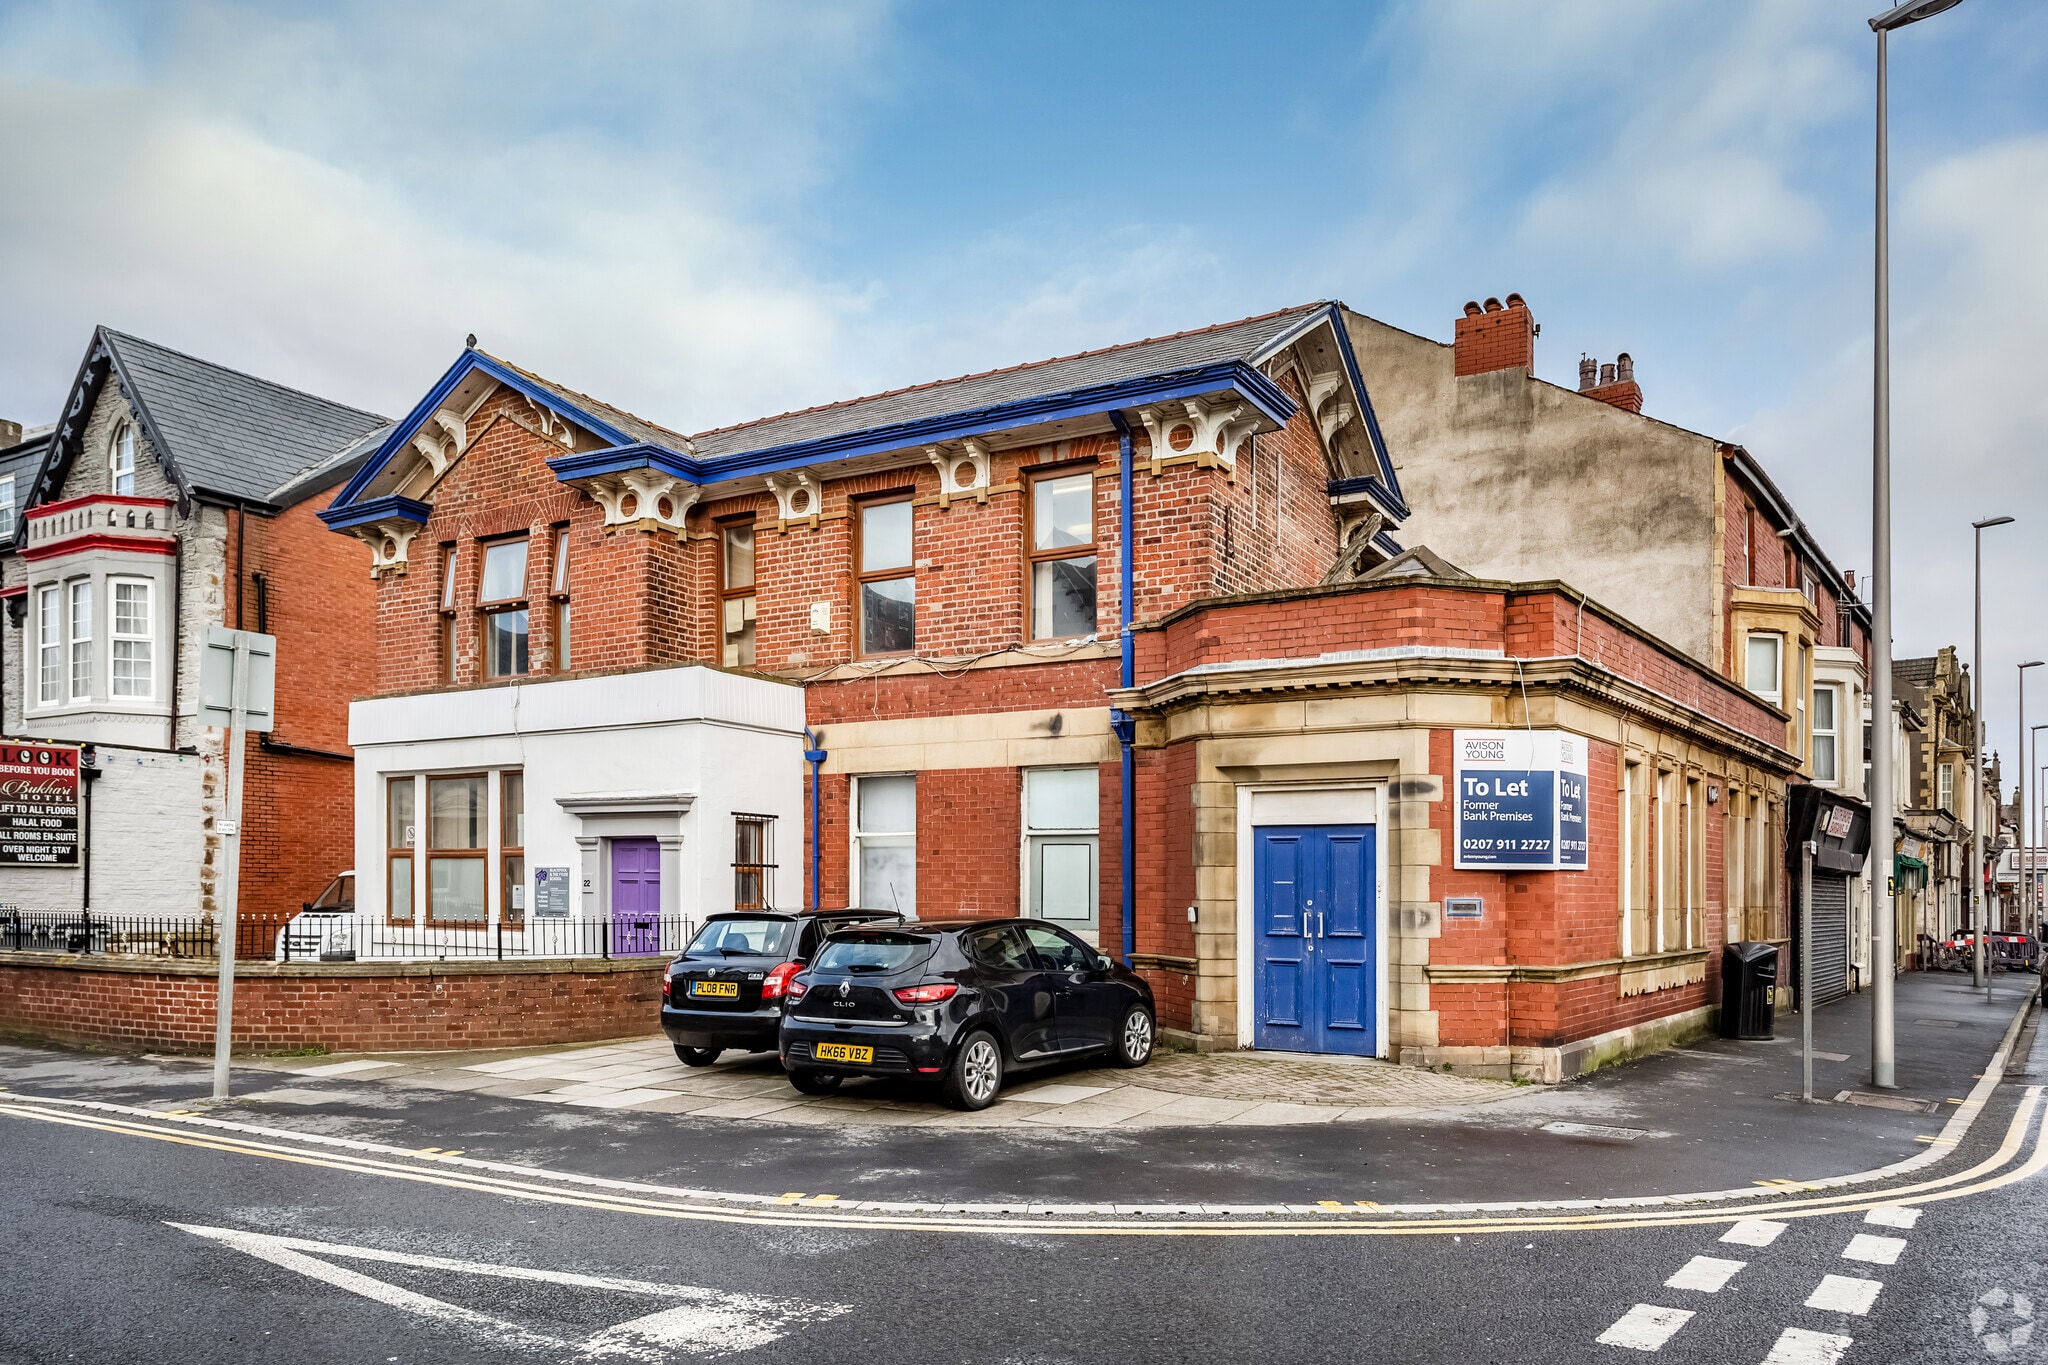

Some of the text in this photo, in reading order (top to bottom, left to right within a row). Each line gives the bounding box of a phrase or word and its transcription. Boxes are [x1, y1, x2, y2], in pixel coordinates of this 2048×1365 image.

[1465, 741, 1504, 750] AVISON
[2, 748, 72, 766] LOOK
[1465, 750, 1504, 759] YOUNG
[0, 764, 75, 777] BEFORE YOU BOOK
[0, 778, 72, 797] Bukhari
[1463, 778, 1528, 796] To Let
[1560, 779, 1581, 799] To Let
[20, 794, 73, 802] HOTEL
[16, 804, 27, 813] TO
[29, 805, 44, 814] ALL
[46, 806, 77, 815] FLOORS
[1463, 800, 1499, 810] Former
[1463, 811, 1533, 821] Bank Premises
[12, 817, 62, 827] HALAL FOOD
[13, 831, 41, 840] ROOMS
[43, 832, 77, 841] EN-SUITE
[2, 845, 71, 854] OVER NIGHT STAY
[1463, 839, 1550, 850] 0207 911 2727
[17, 854, 58, 862] WELCOME
[583, 879, 591, 887] 22
[696, 983, 736, 995] PL08 FNR
[820, 1045, 868, 1060] HK66 VBZ
